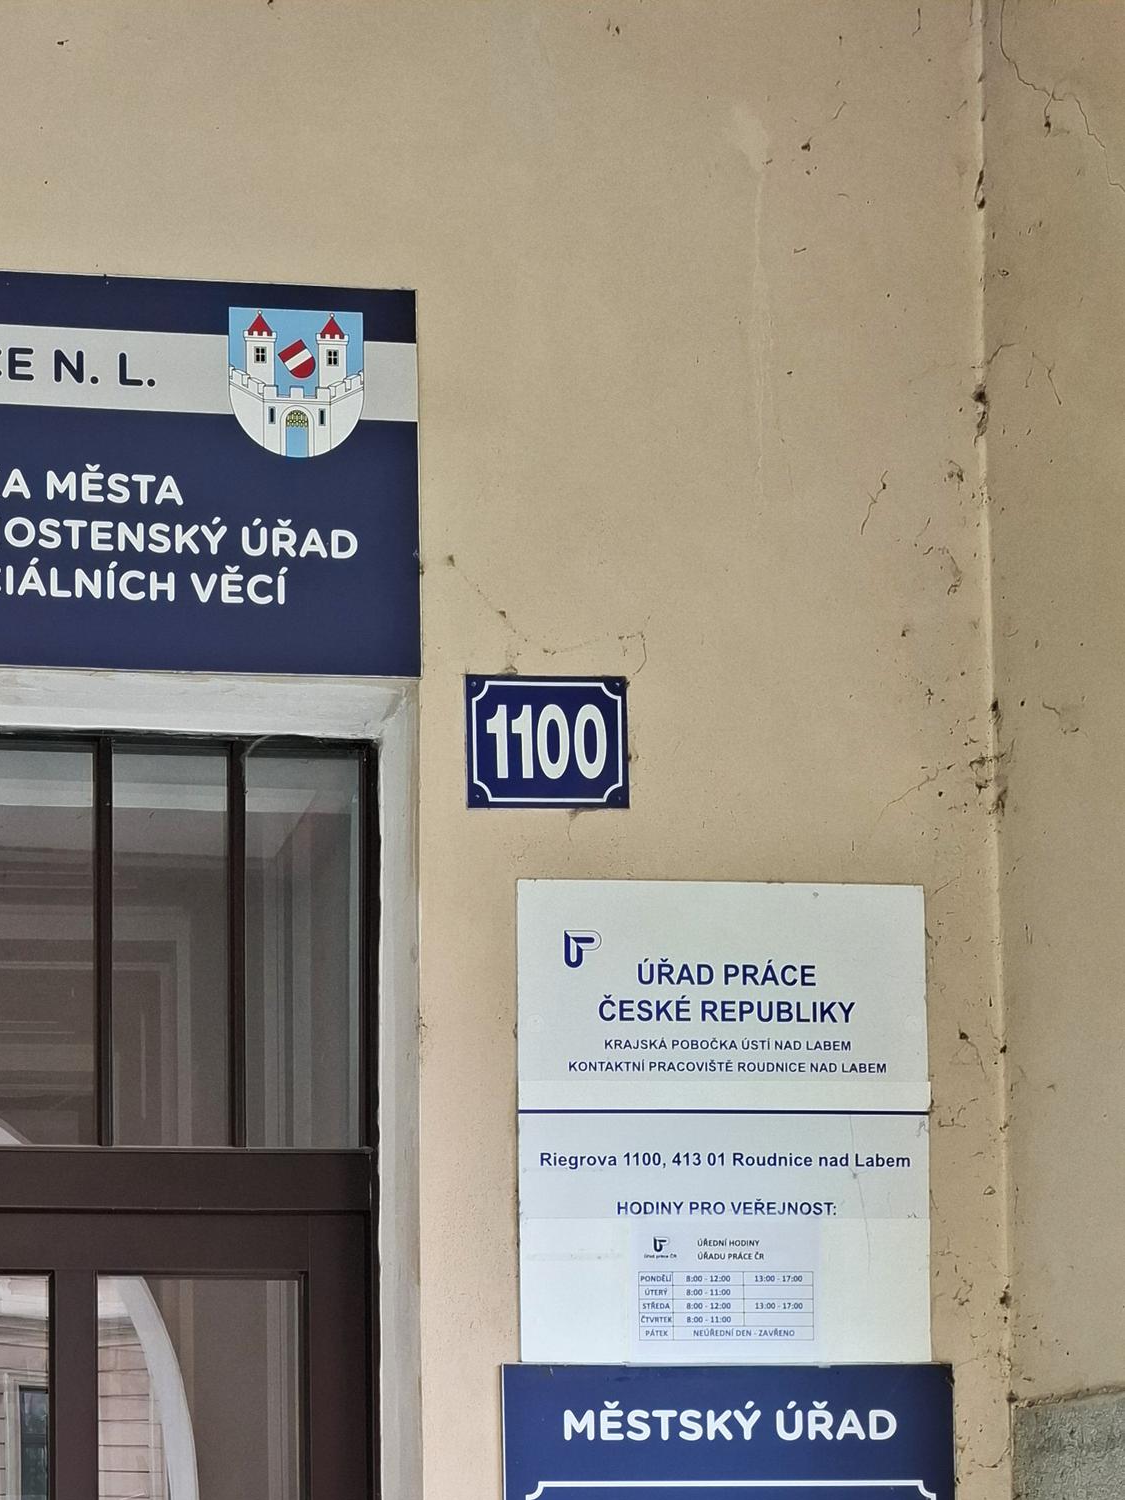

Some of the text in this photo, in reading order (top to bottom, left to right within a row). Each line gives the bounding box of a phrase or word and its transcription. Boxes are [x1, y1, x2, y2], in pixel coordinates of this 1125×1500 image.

[53, 349, 99, 385] N.
[118, 352, 156, 388] L.
[46, 463, 184, 506] MĚSTA
[241, 517, 358, 559] ÚŘAD
[190, 564, 289, 605] VĚCÍ
[486, 703, 608, 780] 1100
[637, 957, 817, 987] ÚŘAD PRÁCE
[598, 994, 856, 1024] ČESKÉ REPUBLIKY
[604, 1037, 851, 1052] KRAJSKÁ POBOČKA ÚSTÍ NAD LABEM
[568, 1058, 887, 1074] KONTAKTNÍ PRACOVIŠTĚ ROUDNICE NAD LABEM
[540, 1151, 911, 1170] Riegrova 1100, 413 01 Roudnice nad Labem
[617, 1198, 837, 1216] HODINY PRO VEŘEJNOST:
[697, 1237, 760, 1247] ÚŘEDNÍ HODINY
[697, 1251, 765, 1260] ÚŘADU PRÁCE ČR
[640, 1274, 672, 1282] PONDĚLÍ
[644, 1288, 668, 1296] ÚTERÝ
[642, 1302, 670, 1310] STŘEDA
[640, 1315, 672, 1323] ČTVRTEK
[645, 1329, 668, 1337] PÁTEK
[693, 1328, 735, 1337] NEÚŘEDNÍ
[758, 1328, 795, 1337] ZAVŘENO
[563, 1400, 897, 1442] MĚSTSKÝ ÚŘAD
